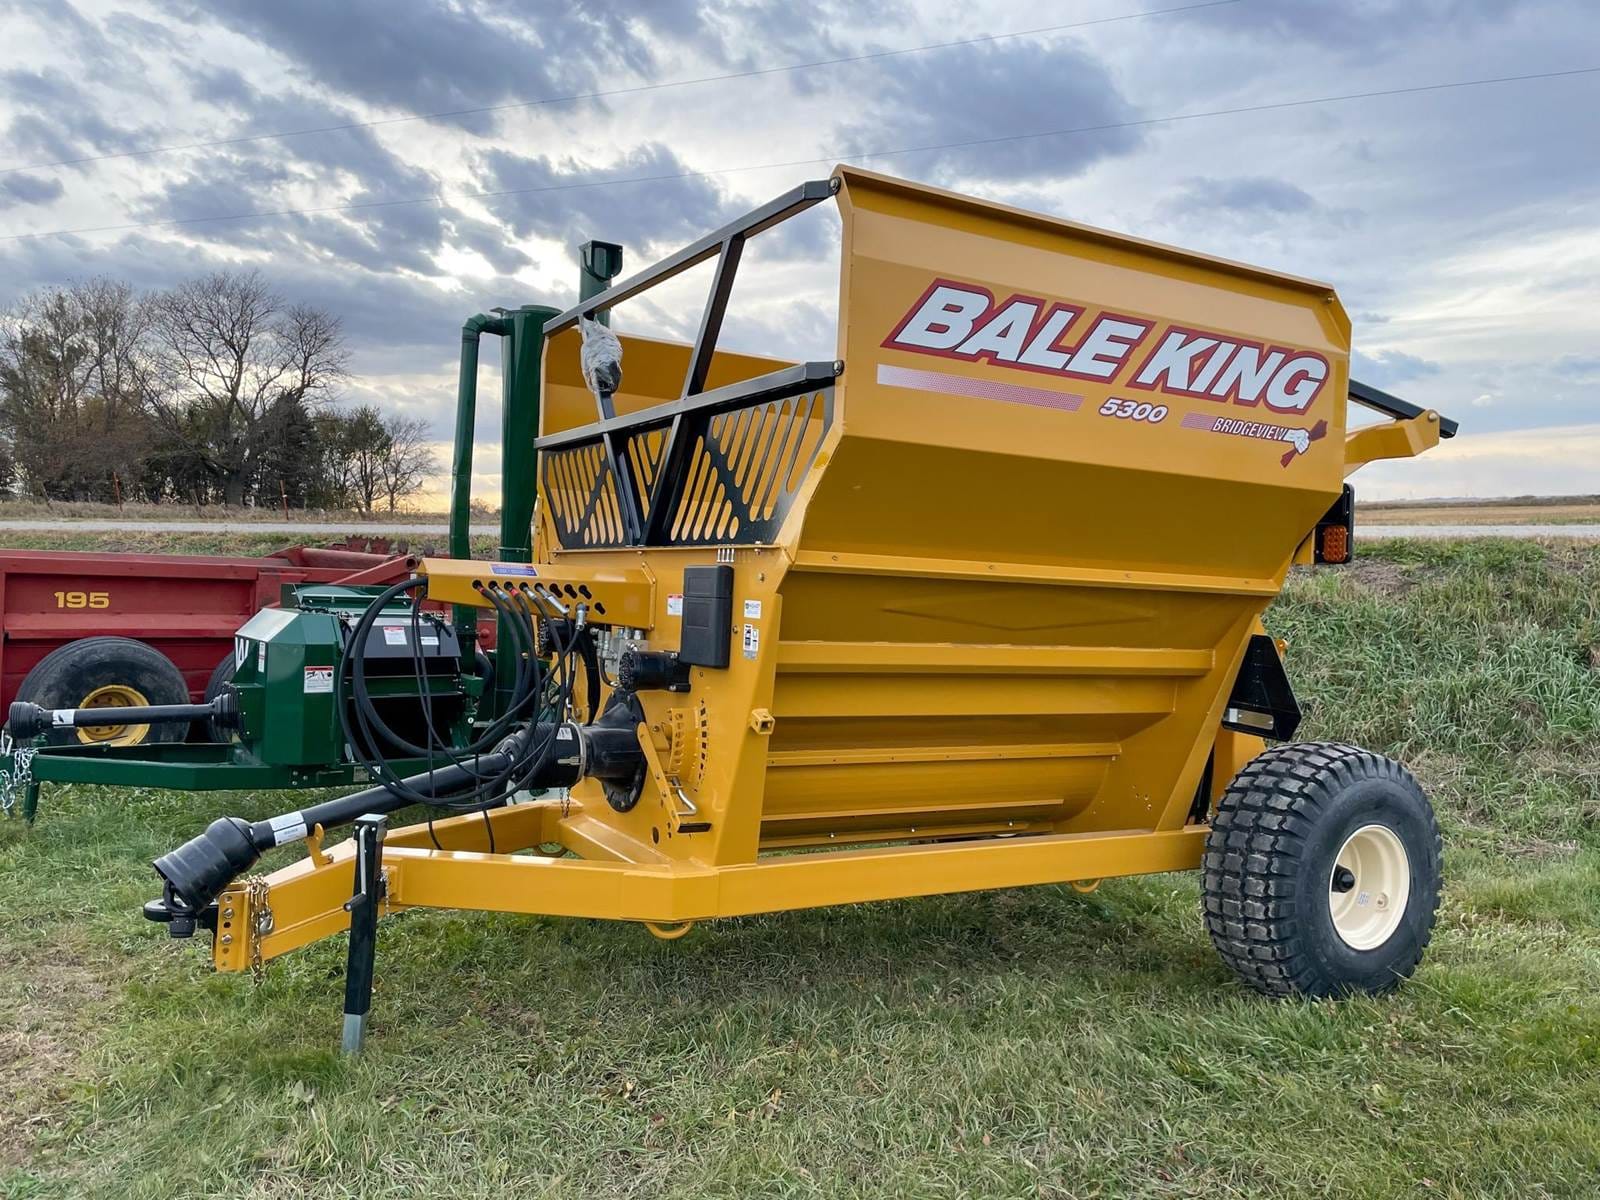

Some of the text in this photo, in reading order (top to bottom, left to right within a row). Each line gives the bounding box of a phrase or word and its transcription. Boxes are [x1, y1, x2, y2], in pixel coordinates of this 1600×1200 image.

[890, 283, 1328, 411] BALE KING
[1099, 397, 1168, 423] 5300
[1213, 417, 1288, 441] BRIDGEVIEW
[54, 591, 110, 609] 195
